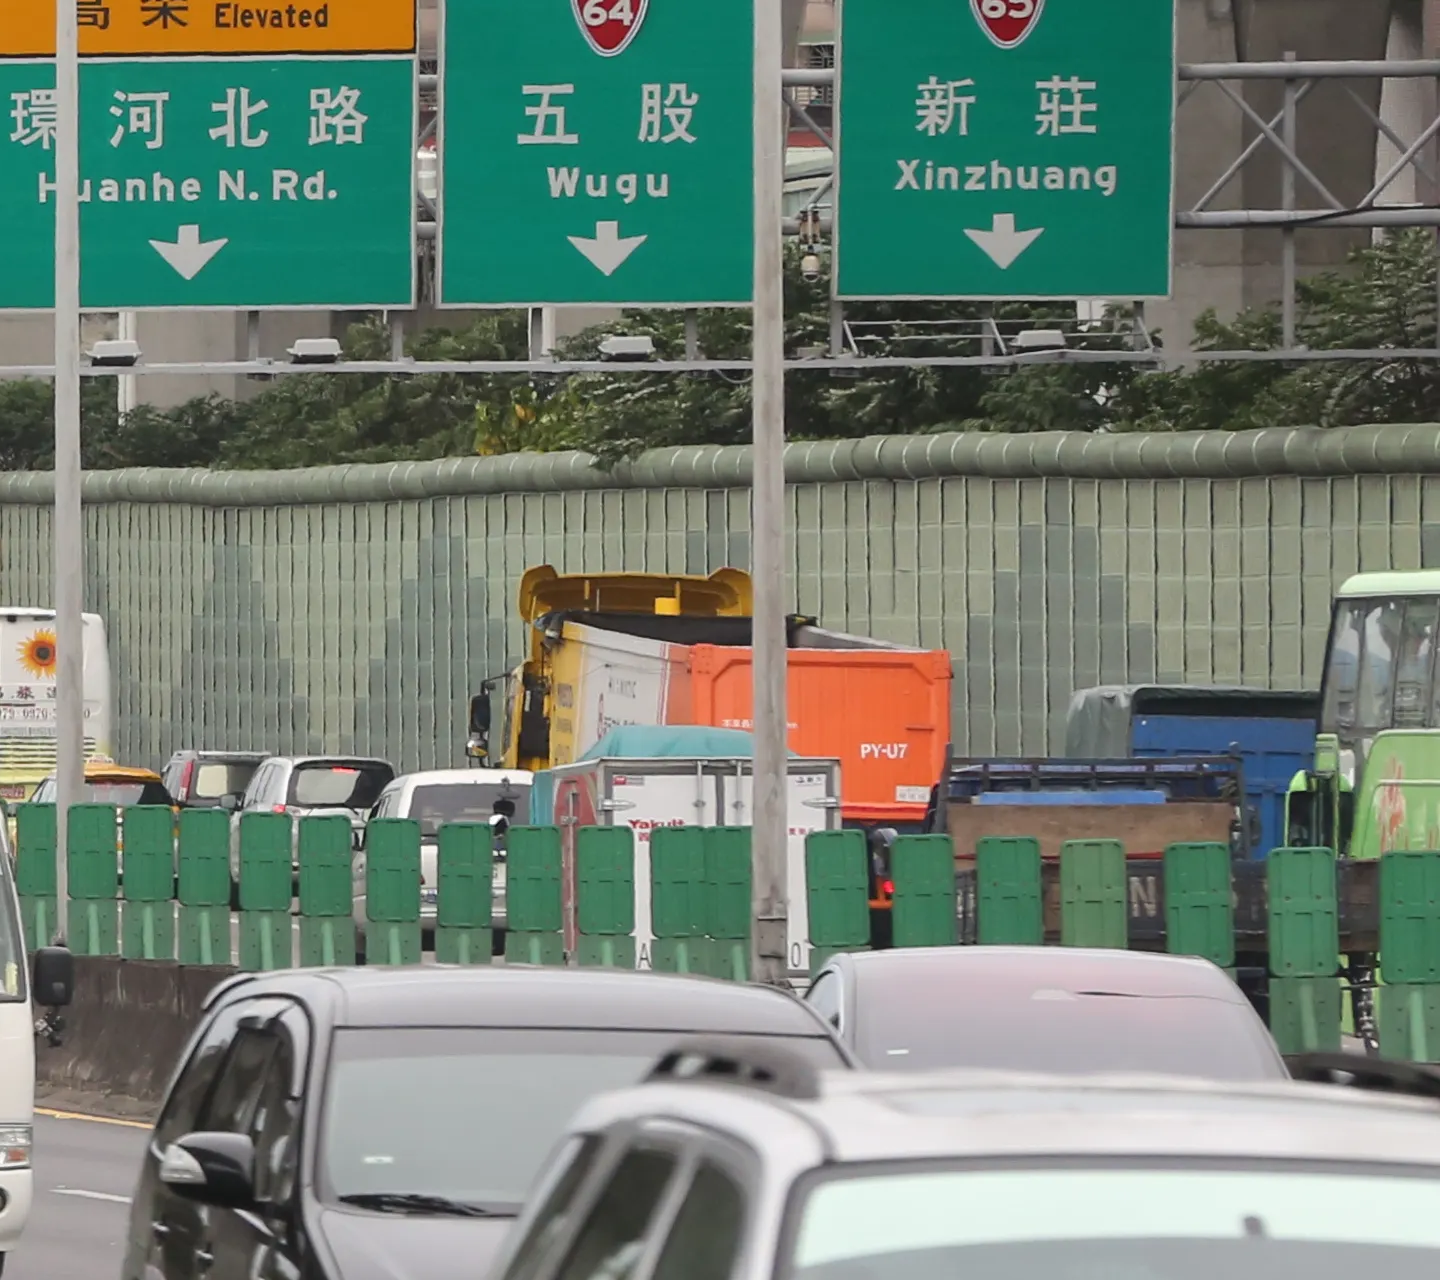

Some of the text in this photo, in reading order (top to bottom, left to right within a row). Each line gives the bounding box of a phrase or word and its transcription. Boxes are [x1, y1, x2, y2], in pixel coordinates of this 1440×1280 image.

[215, 4, 328, 29] Elevated
[11, 86, 369, 149] 環河北路
[517, 83, 699, 146] 五股
[915, 76, 1098, 137] 新莊
[218, 171, 259, 200] N.
[272, 170, 338, 200] Rd.
[547, 167, 670, 204] Wugu
[894, 159, 1117, 196] Xinzhuang
[861, 743, 908, 758] PY-U7
